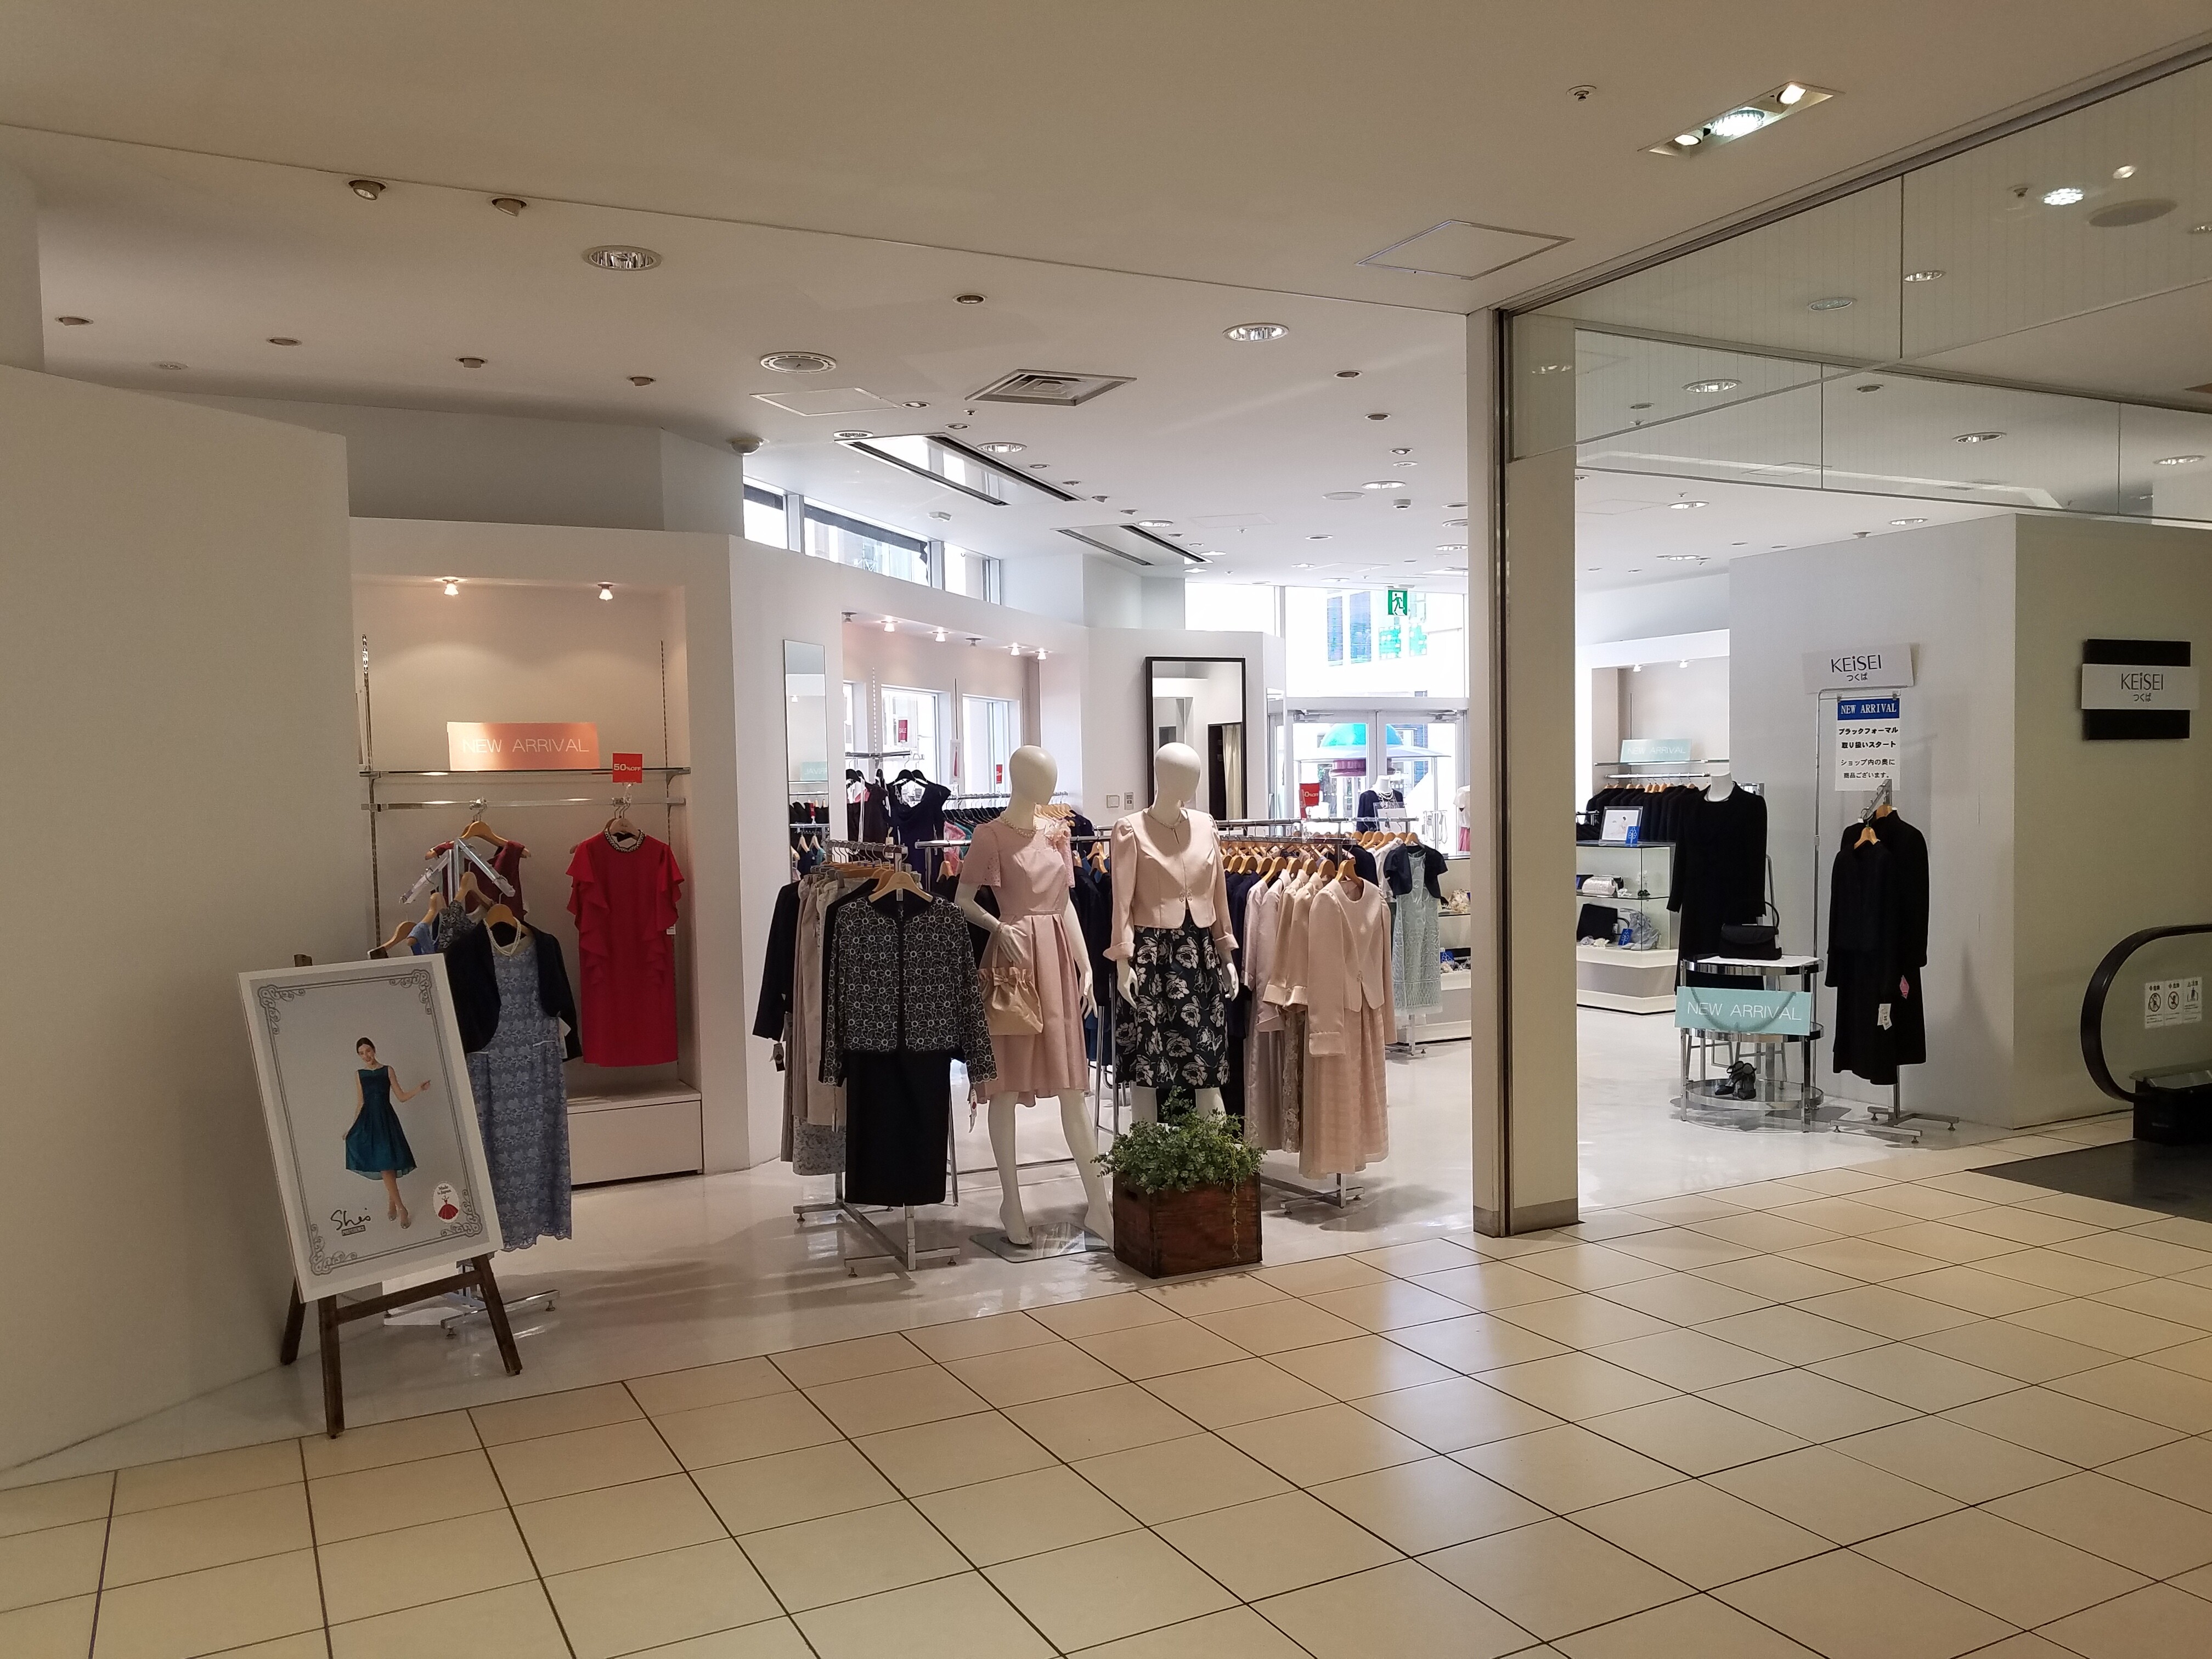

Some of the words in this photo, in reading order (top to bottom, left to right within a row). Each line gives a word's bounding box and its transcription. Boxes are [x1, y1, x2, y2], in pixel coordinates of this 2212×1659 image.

[1841, 704, 1857, 714] NEW
[1860, 703, 1897, 714] ARRIVAL
[462, 738, 502, 753] NEW
[512, 738, 590, 753] ARRIVAL
[1628, 747, 1645, 755] NEW
[1649, 746, 1686, 754] ARRIVAL
[613, 763, 641, 771] 50%OFF
[1687, 1001, 1723, 1016] NEW
[1730, 1005, 1802, 1020] ARRIVAL
